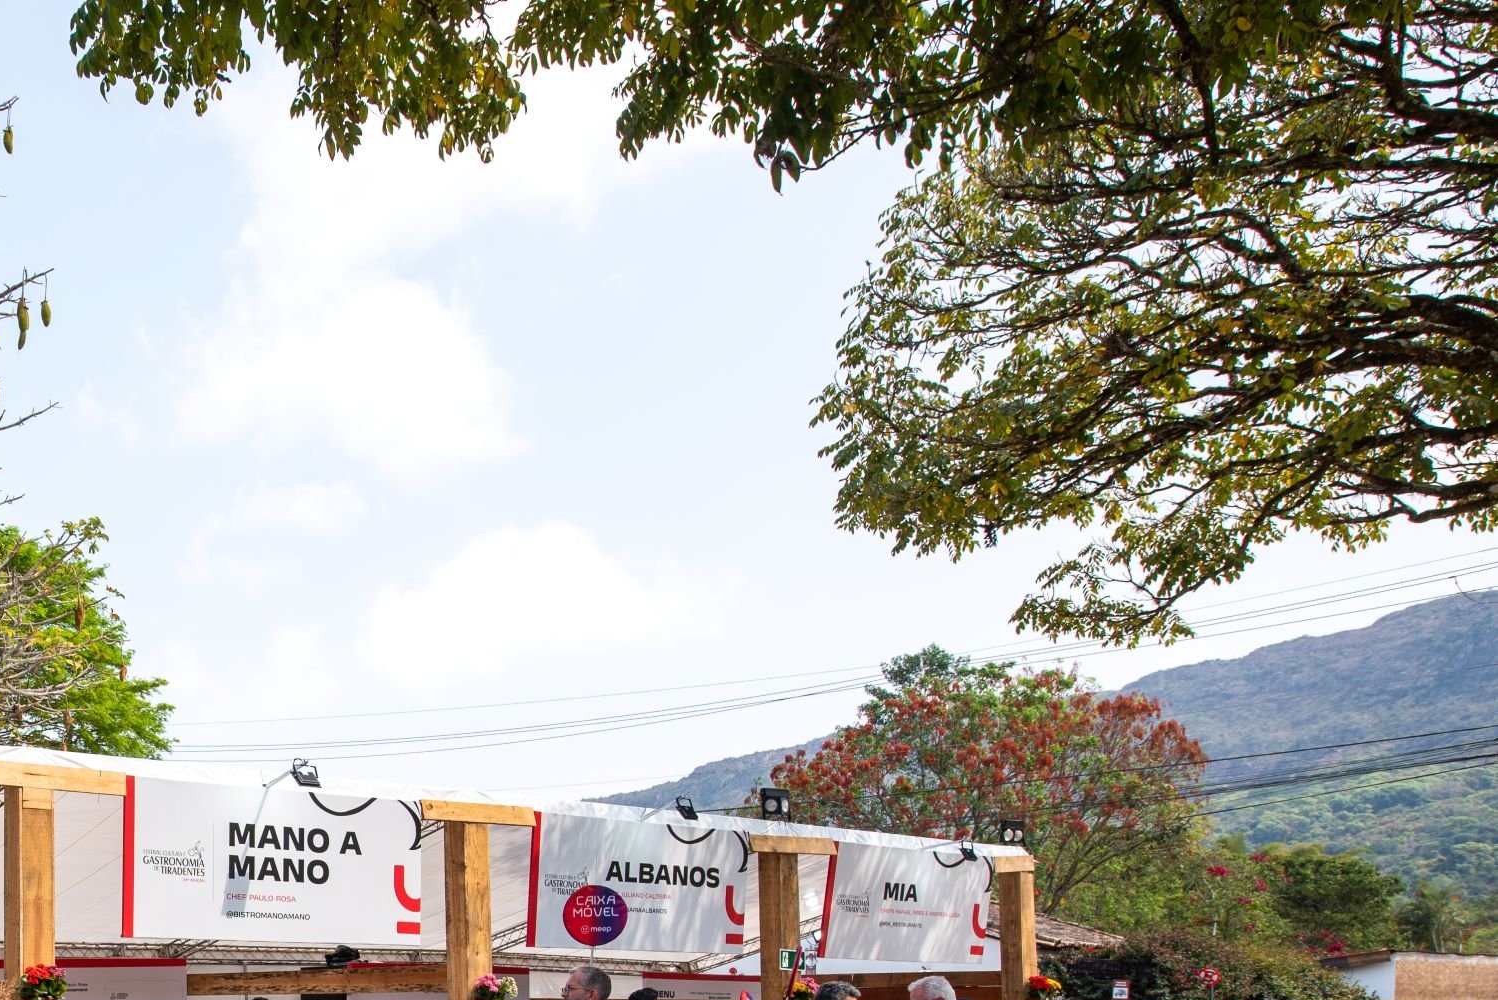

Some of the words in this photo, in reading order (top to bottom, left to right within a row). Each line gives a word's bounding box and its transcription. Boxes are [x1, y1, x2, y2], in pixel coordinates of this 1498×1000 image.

[228, 822, 330, 853] MANO
[339, 831, 363, 856] A
[142, 855, 205, 868] GASTRONOMIA
[160, 866, 205, 876] TIRADENTES
[228, 854, 330, 885] MANO
[605, 861, 720, 889] ALBANOS
[226, 893, 247, 901] CHEF
[249, 894, 274, 902] PAULO
[275, 895, 297, 903] ROSA
[883, 882, 918, 902] MIA
[576, 895, 616, 906] CAIXA
[226, 910, 310, 921] @BISTROMANOAMANO
[573, 904, 619, 918] MÓVEL
[591, 925, 612, 933] meep
